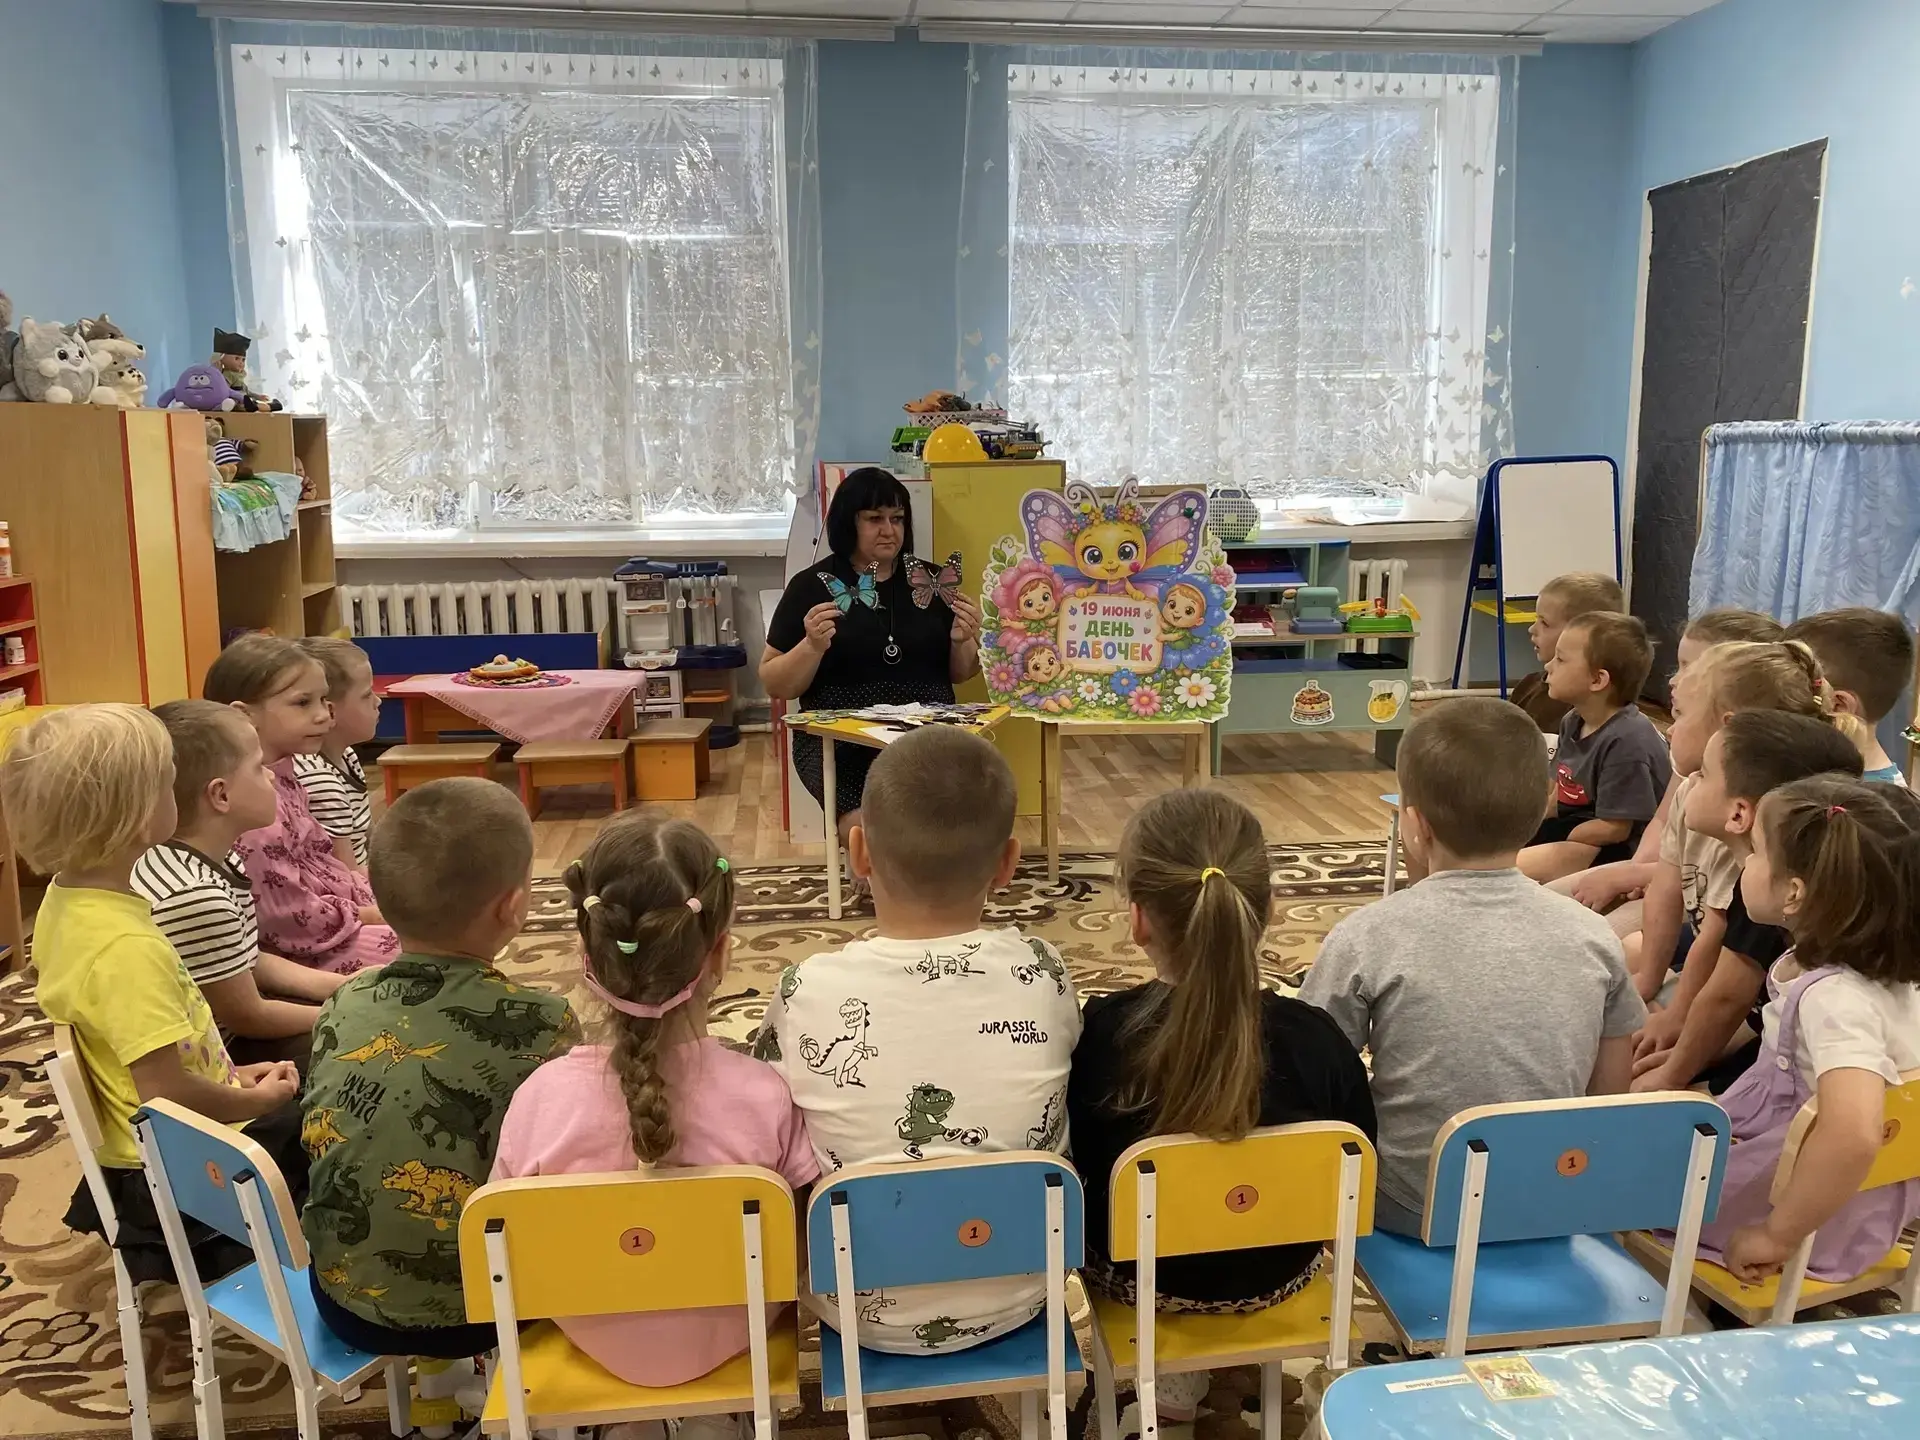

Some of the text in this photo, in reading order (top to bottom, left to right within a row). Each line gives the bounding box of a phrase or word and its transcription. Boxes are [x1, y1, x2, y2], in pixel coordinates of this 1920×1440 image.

[1081, 602, 1098, 616] 19
[1085, 620, 1135, 638] ДЕНЬ
[1066, 640, 1153, 661] БАБОЧЕК
[978, 1020, 1037, 1035] JURASSIC
[1010, 1031, 1048, 1045] WORLD
[344, 1071, 387, 1106] TEAM
[1567, 1156, 1577, 1170] 1
[1237, 1192, 1247, 1206] 1
[969, 1226, 979, 1240] 1
[632, 1235, 642, 1249] 1
